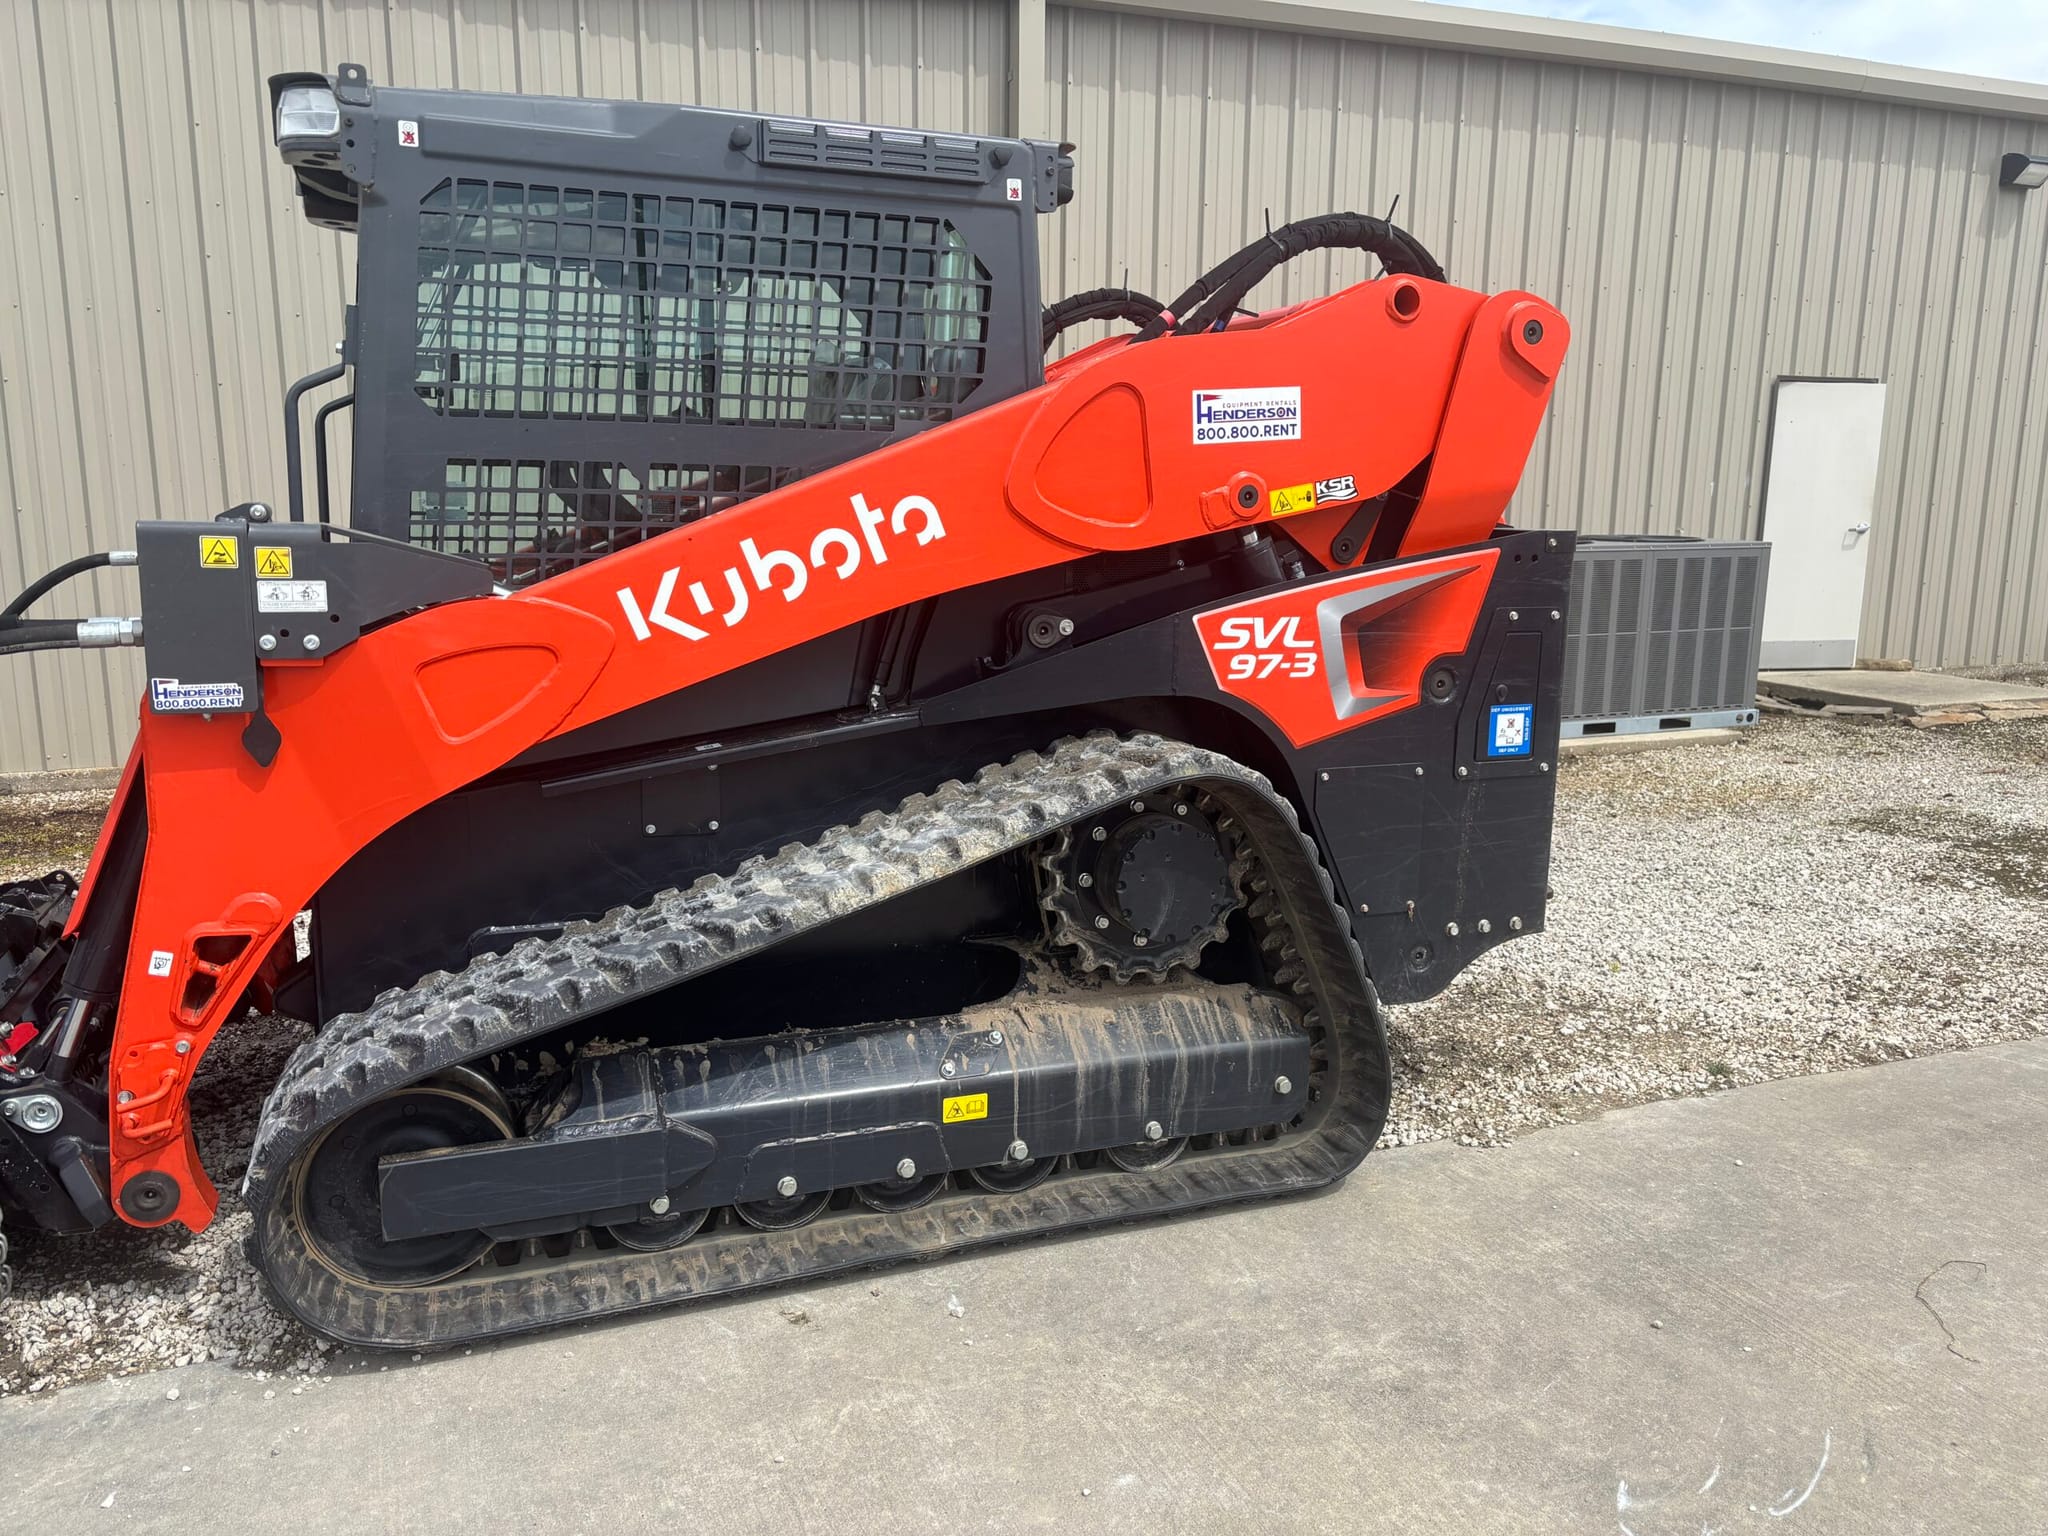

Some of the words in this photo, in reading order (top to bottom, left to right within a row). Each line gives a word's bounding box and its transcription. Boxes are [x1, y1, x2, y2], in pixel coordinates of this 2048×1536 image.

[1197, 394, 1297, 424] HENDERSON
[1222, 401, 1263, 409] EQUIPMENT
[1197, 424, 1297, 440] 800.800.RENT
[1316, 475, 1354, 494] KSR
[616, 493, 946, 641] Kubota
[1213, 616, 1315, 650] SVL
[1227, 652, 1318, 680] 97-3
[153, 680, 242, 699] HENDERSON
[156, 698, 242, 709] 800.800.RENT
